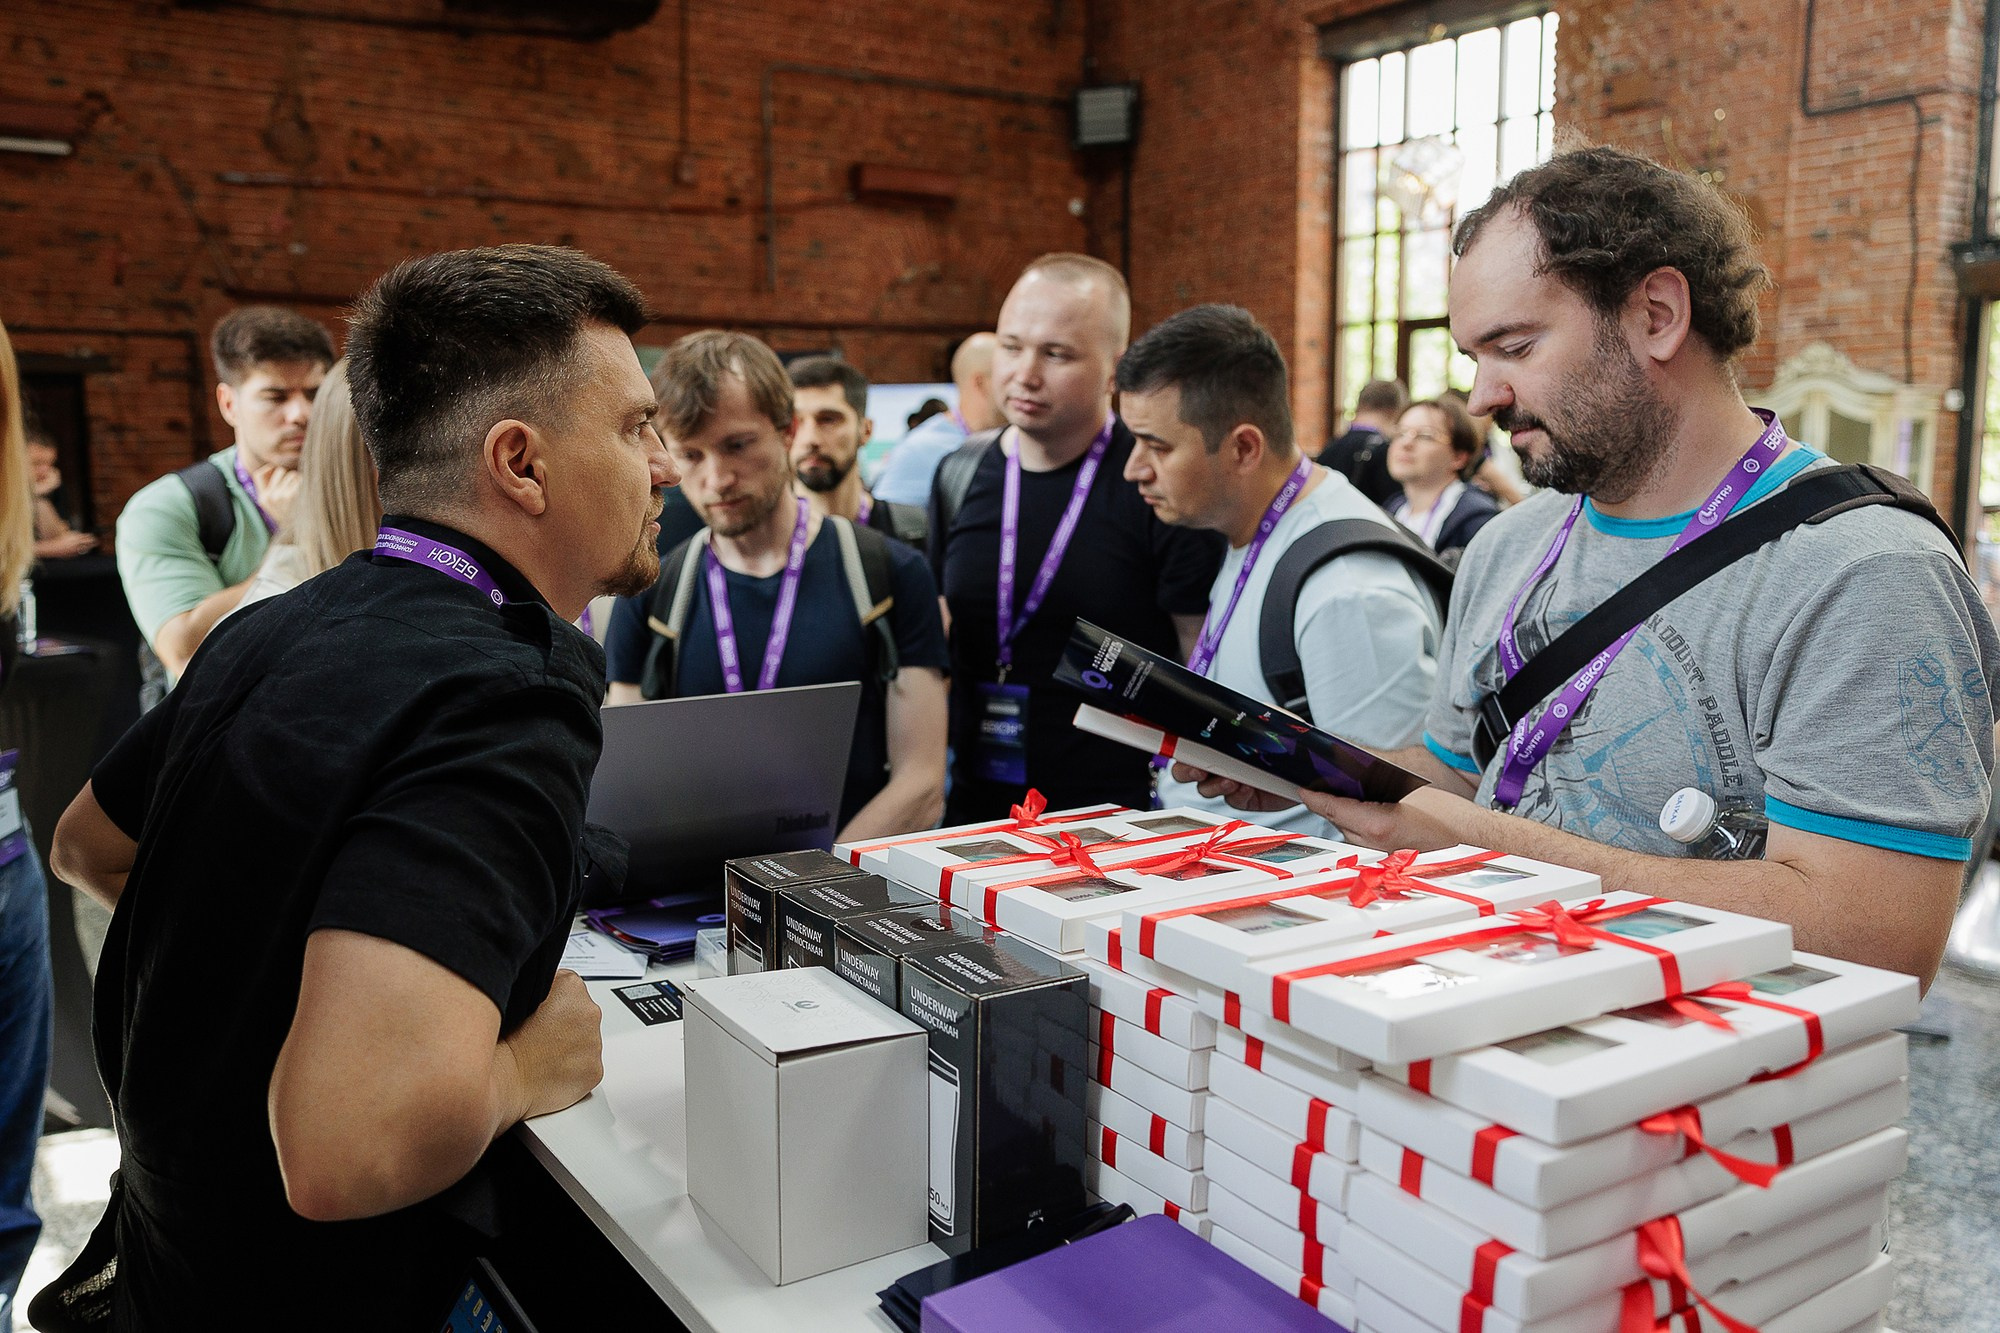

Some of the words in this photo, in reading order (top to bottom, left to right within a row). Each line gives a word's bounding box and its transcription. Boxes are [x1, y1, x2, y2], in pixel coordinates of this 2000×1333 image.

[1762, 425, 1786, 451] БЕКО
[1701, 484, 1733, 518] LUNTRY
[427, 547, 479, 580] БЕКОН
[1573, 650, 1611, 693] БЕКОН
[1658, 624, 1706, 691] DOUBT:
[1698, 694, 1744, 788] PADDLE
[1519, 728, 1545, 760] LUNTRY
[730, 885, 761, 911] UNDERWAY
[730, 899, 762, 924] ТЕРМОСТАКАН
[785, 915, 822, 944] UNDERWAY
[785, 929, 824, 957] ТЕРМОСТАКАН
[878, 918, 926, 941] UNDERWAY
[840, 948, 880, 981] UNDERWAY
[841, 964, 881, 996] ТЕРМОСТАКАН
[948, 952, 1003, 980] UNDERWAY
[910, 985, 958, 1023] UNDERWAY
[910, 1002, 959, 1040] ТЕРМОСТАКАН
